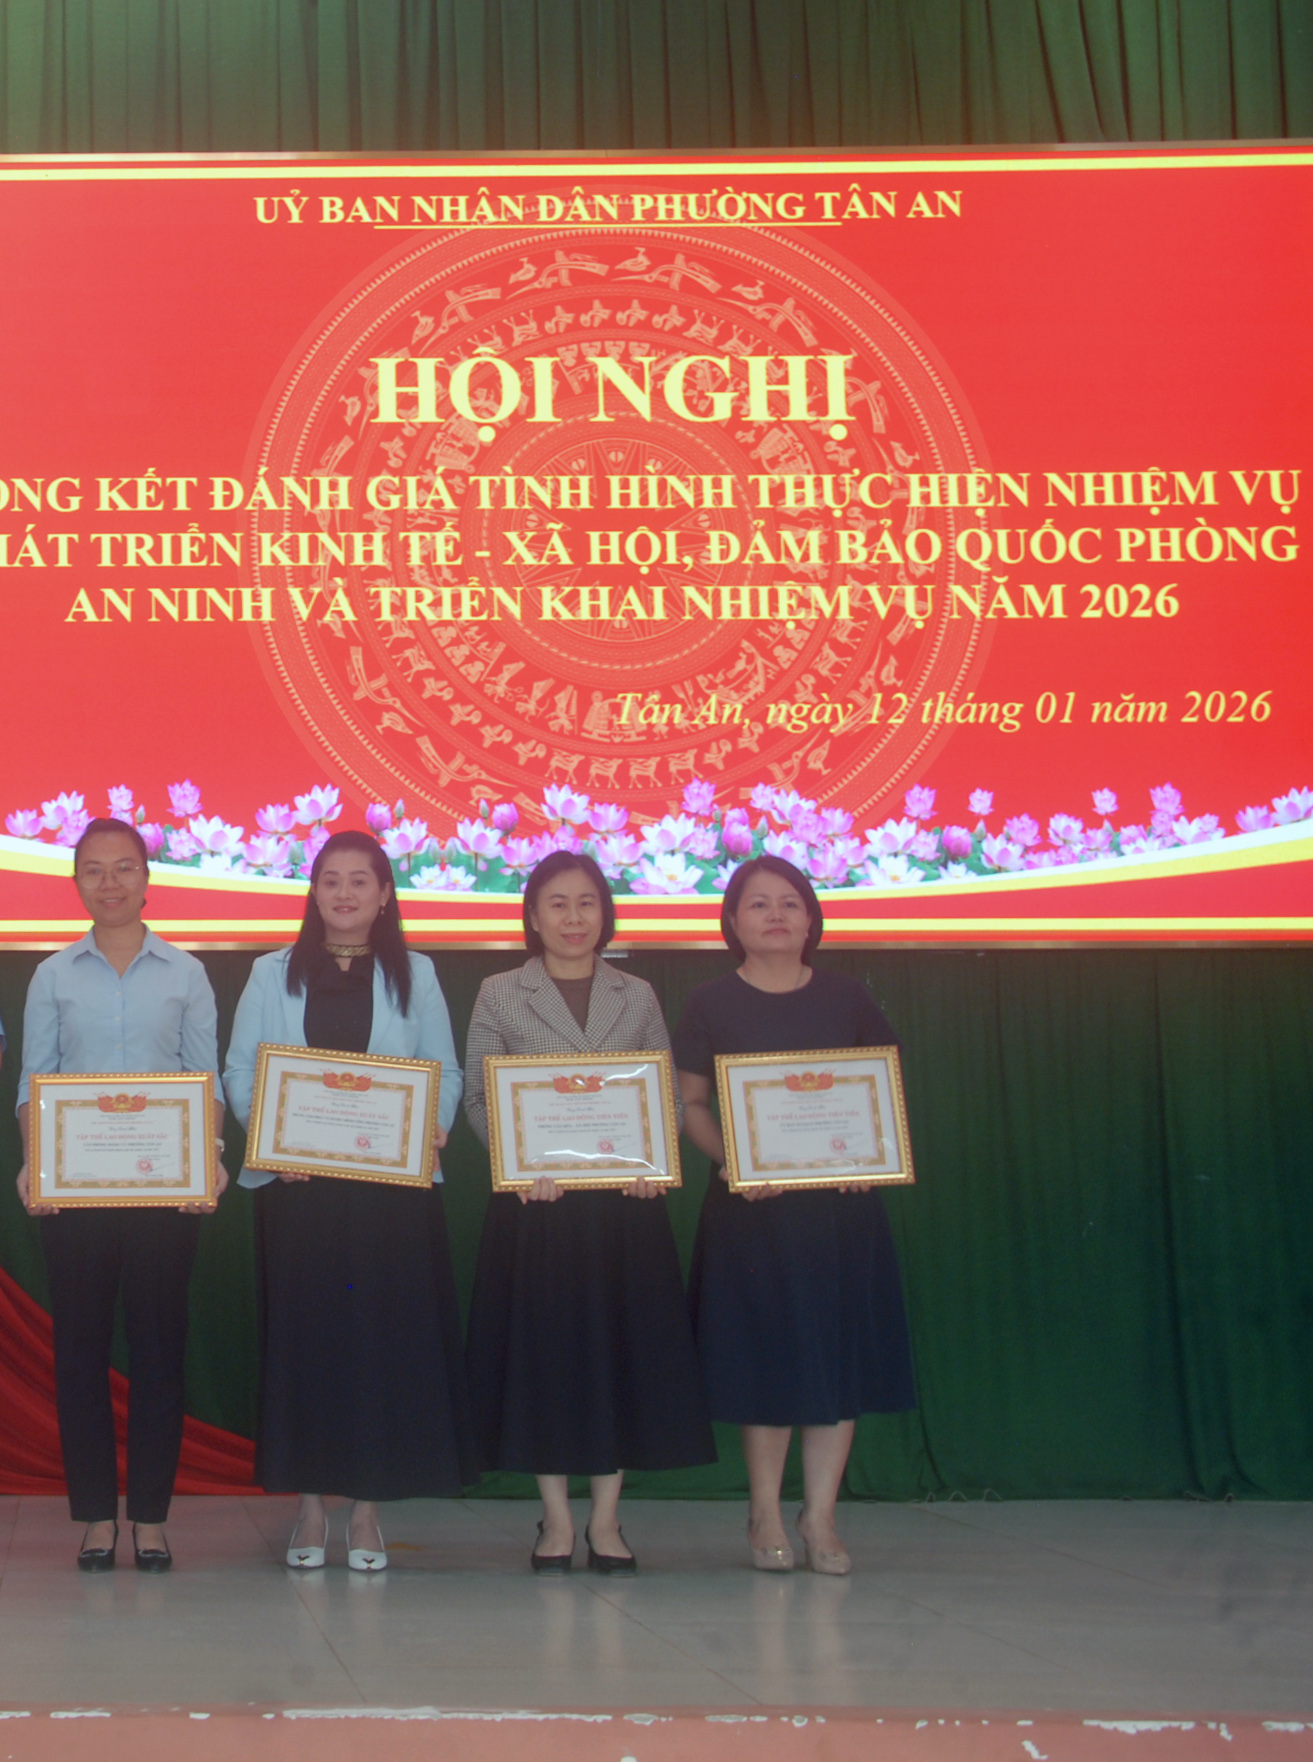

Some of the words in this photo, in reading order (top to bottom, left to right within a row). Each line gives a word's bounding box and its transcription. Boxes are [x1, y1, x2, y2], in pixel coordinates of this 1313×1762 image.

[254, 189, 308, 221] UỶ
[320, 196, 400, 221] BAN
[411, 187, 525, 221] NHÂN
[536, 186, 619, 221] DÂN
[631, 186, 805, 221] PHƯỜNG
[815, 183, 896, 219] TÂN
[907, 191, 960, 218] AN
[369, 346, 562, 443] HỘI
[587, 354, 856, 441] NGHỊ
[96, 467, 198, 511] KẾT
[209, 466, 353, 511] ĐÁNH
[366, 465, 458, 511] GIÁ
[469, 465, 593, 510] TÌNH
[606, 464, 737, 509] HÌNH
[748, 468, 892, 518] THỰC
[906, 468, 1029, 517] HIỆN
[1044, 466, 1217, 515] NHIỆM
[1230, 470, 1299, 514] VỤ
[90, 523, 243, 567] TRIỂN
[257, 531, 388, 567] KINH
[399, 521, 463, 566] TẾ
[474, 549, 491, 558] -
[503, 522, 573, 565] XÃ
[586, 526, 693, 575] HỘI,
[705, 519, 823, 565] ĐẢM
[835, 518, 942, 565] BẢO
[955, 518, 1101, 571] QUỐC
[1116, 517, 1298, 562] PHÒNG
[65, 588, 134, 622] AN
[148, 587, 275, 622] NINH
[287, 577, 358, 622] VÀ
[370, 576, 523, 622] TRIỂN
[538, 586, 667, 621] KHAI
[681, 580, 853, 630] NHIỆM
[864, 585, 935, 629] VỤ
[948, 576, 1067, 620] NĂM
[1081, 583, 1179, 618] 2026
[615, 693, 683, 725] Tân
[690, 693, 750, 730] An,
[766, 692, 853, 734] ngày
[867, 692, 908, 724] 12
[921, 691, 1024, 733] tháng
[1036, 692, 1075, 723] 01
[1091, 692, 1167, 723] năm
[1181, 690, 1271, 722] 2026
